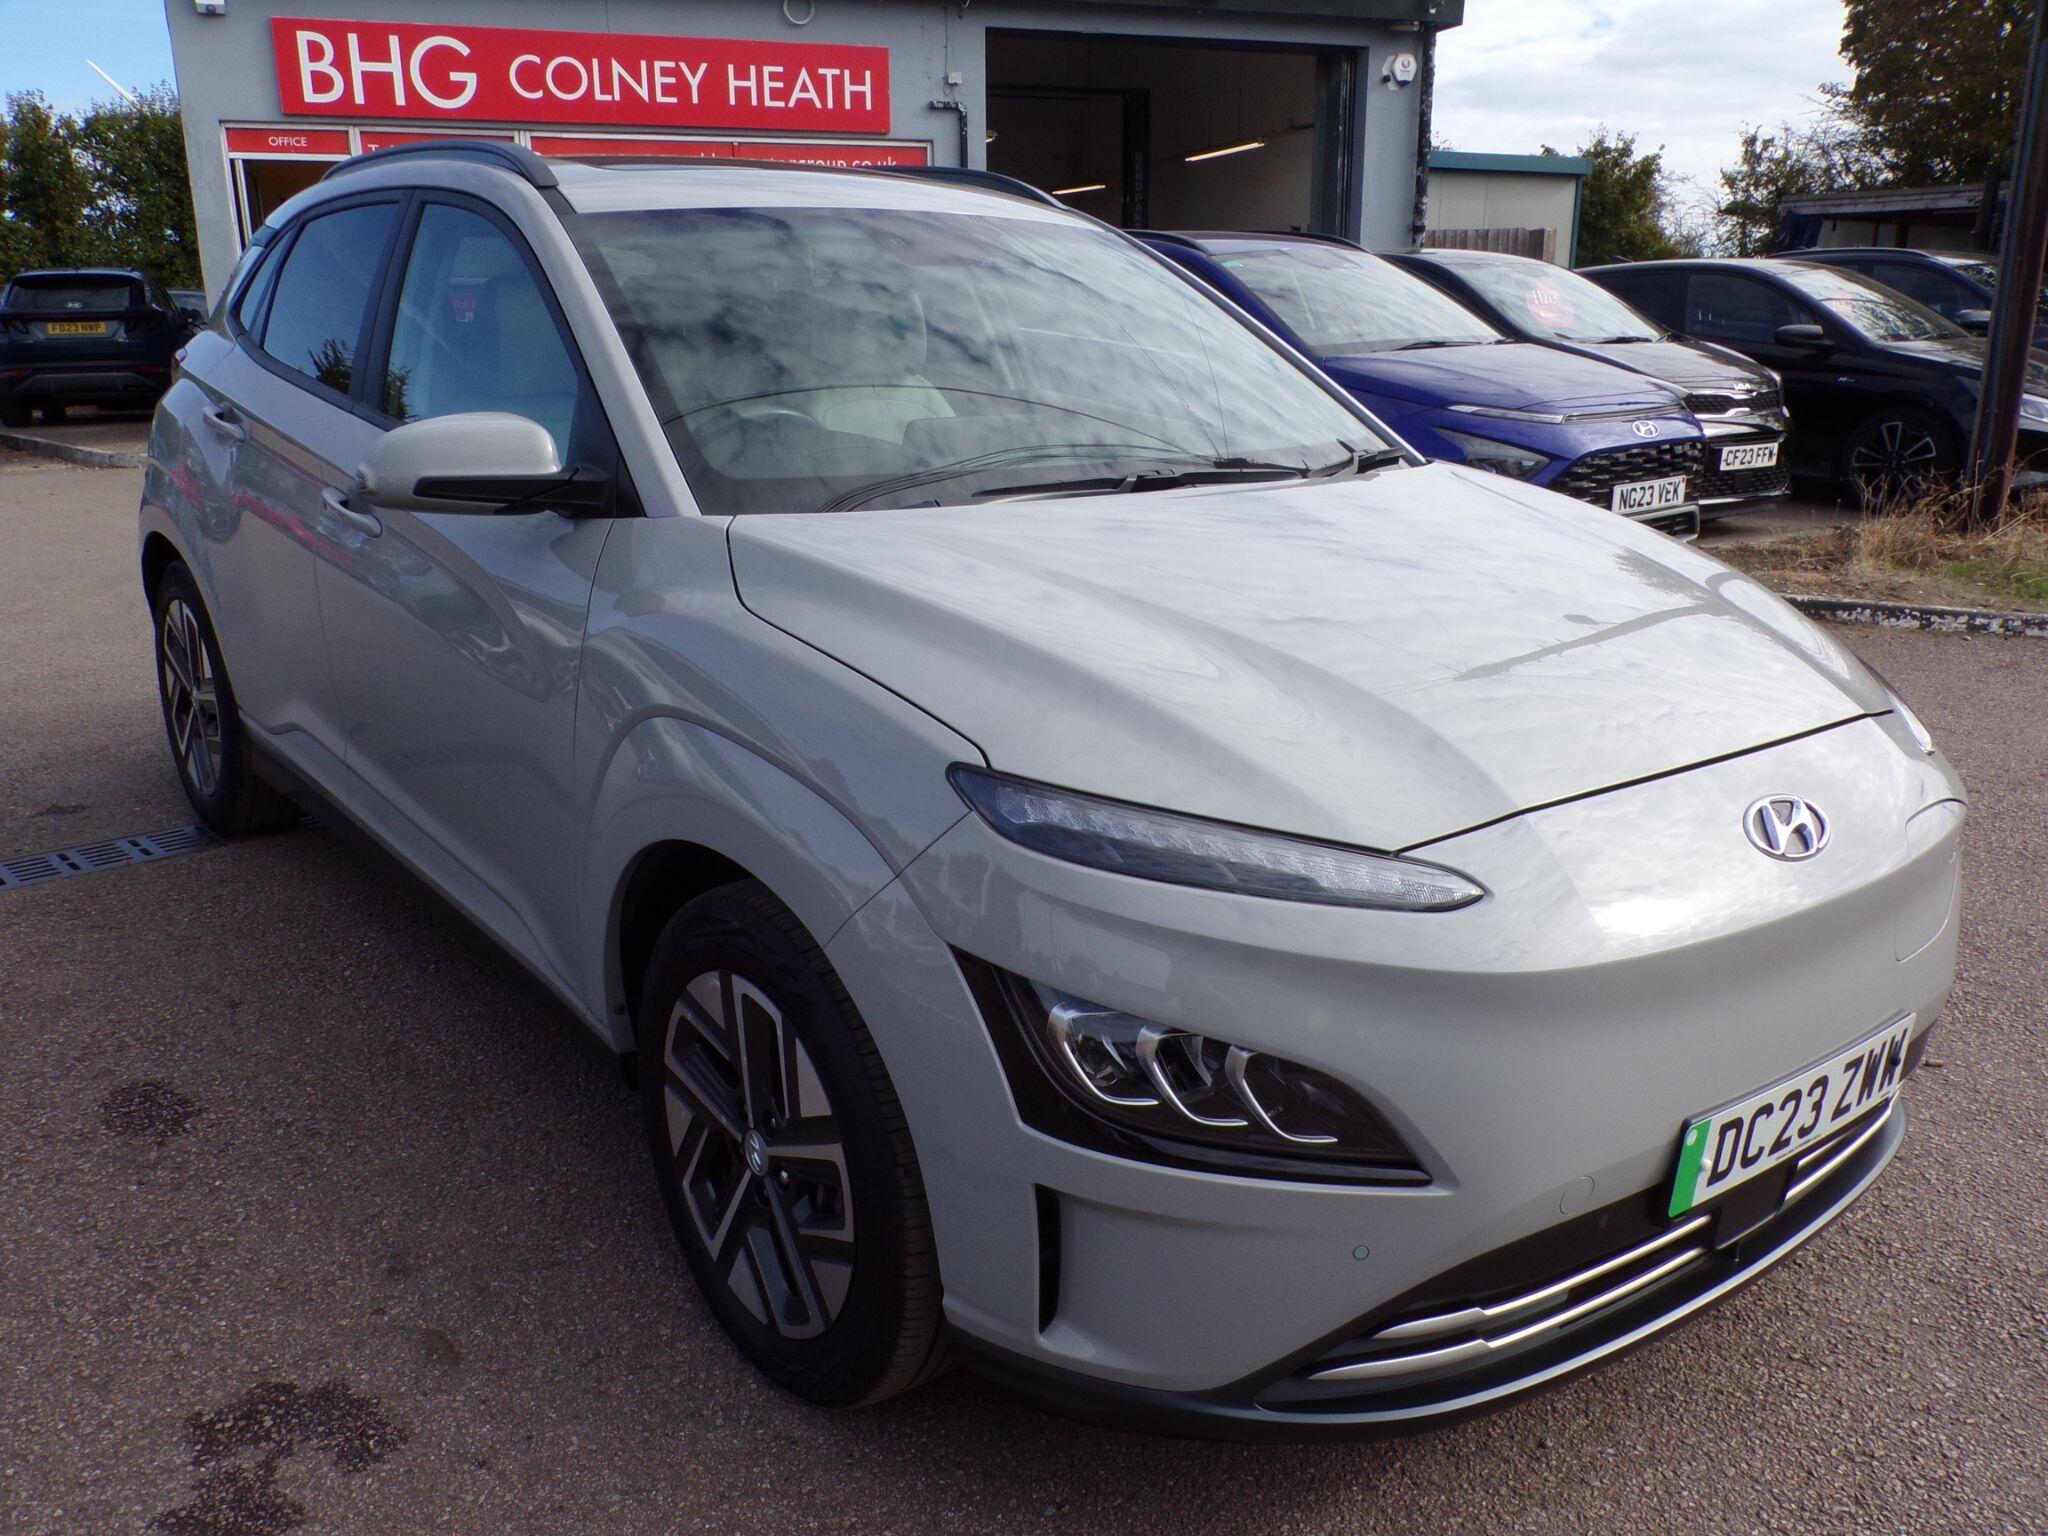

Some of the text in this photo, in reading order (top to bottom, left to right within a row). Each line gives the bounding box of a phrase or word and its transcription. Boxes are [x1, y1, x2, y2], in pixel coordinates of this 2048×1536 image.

[296, 30, 872, 111] BHG COLNEY HEATH
[268, 136, 308, 147] OFFICE
[1725, 448, 1754, 466] CF23
[1618, 480, 1681, 511] NG23 VEK
[1706, 1074, 1829, 1188] DC23
